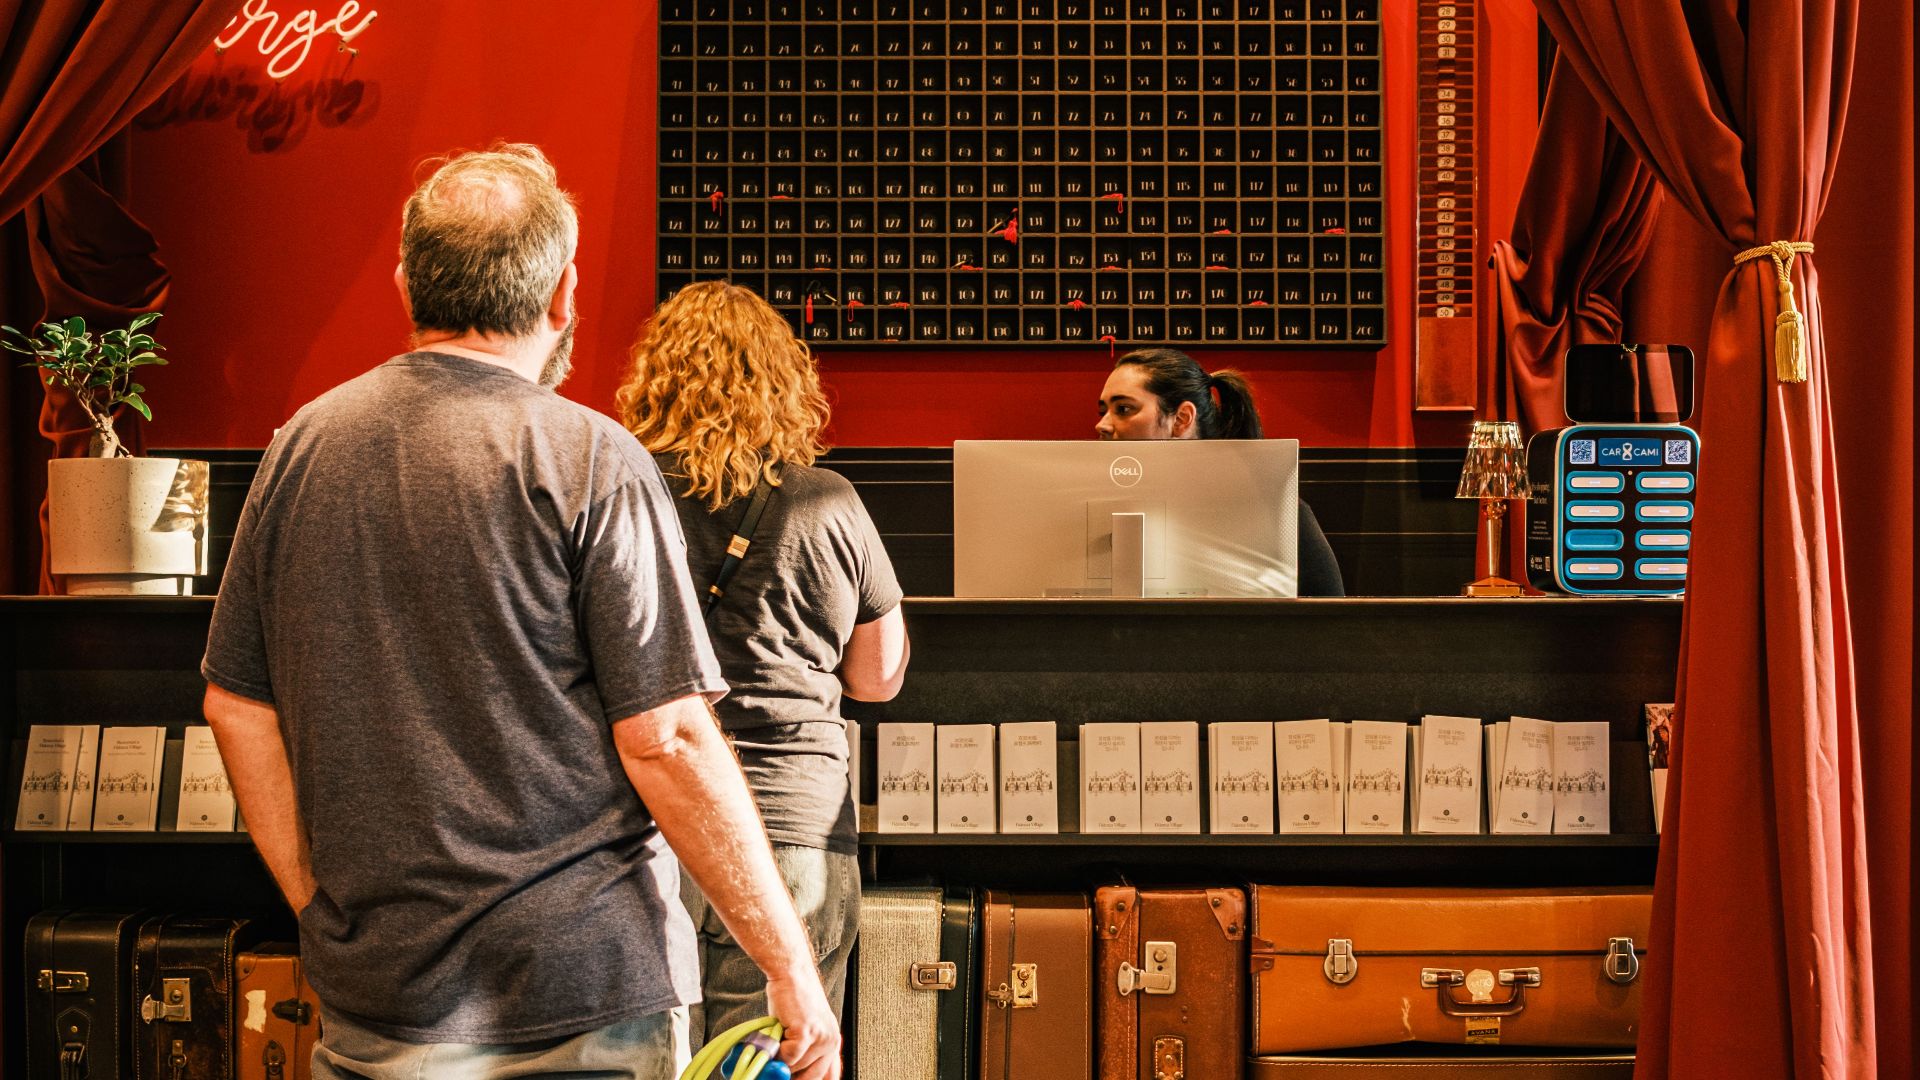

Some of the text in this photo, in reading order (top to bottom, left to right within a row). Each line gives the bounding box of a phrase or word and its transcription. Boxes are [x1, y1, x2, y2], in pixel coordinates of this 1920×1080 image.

[1441, 7, 1451, 15] 28
[1442, 49, 1450, 57] 31
[1441, 90, 1451, 98] 34
[1441, 117, 1451, 125] 36
[1441, 172, 1450, 180] 40
[670, 184, 685, 195] 101
[703, 183, 719, 193] 102
[742, 183, 759, 194] 103
[814, 184, 831, 195] 105
[885, 184, 903, 195] 107
[956, 183, 974, 194] 109
[992, 183, 1008, 193] 110
[1029, 183, 1042, 193] 111
[1067, 183, 1081, 193] 112
[1104, 181, 1118, 192] 113
[1176, 181, 1191, 191] 115
[1249, 181, 1264, 191] 117
[1323, 183, 1338, 193] 119
[1358, 182, 1374, 193] 120
[1441, 213, 1450, 221] 43
[668, 219, 683, 231] 121
[704, 219, 721, 230] 122
[740, 218, 757, 229] 123
[814, 219, 831, 230] 125
[884, 218, 901, 229] 127
[956, 218, 974, 228] 129
[1028, 216, 1043, 227] 131
[1066, 217, 1082, 228] 132
[1103, 216, 1121, 226] 133
[1176, 215, 1193, 226] 135
[1249, 216, 1266, 227] 137
[1322, 217, 1338, 228] 139
[992, 252, 1007, 264] 150
[1030, 253, 1045, 265] 151
[1069, 255, 1085, 265] 152
[1103, 252, 1119, 263] 153
[1176, 251, 1192, 263] 155
[1249, 252, 1265, 263] 157
[1323, 252, 1339, 263] 159
[993, 289, 1009, 300] 170
[1030, 289, 1045, 300] 171
[1067, 289, 1084, 300] 172
[1101, 290, 1118, 301] 173
[1175, 289, 1192, 300] 175
[1247, 289, 1264, 300] 177
[1320, 292, 1337, 302] 179
[992, 326, 1010, 337] 190
[1029, 325, 1045, 337] 191
[1065, 327, 1082, 337] 192
[1101, 324, 1117, 335] 193
[1176, 325, 1193, 336] 195
[1248, 325, 1265, 336] 197
[1321, 324, 1339, 335] 199
[1355, 325, 1372, 336] 200
[1601, 447, 1659, 457] CAR CAMI
[1113, 467, 1140, 476] DELL
